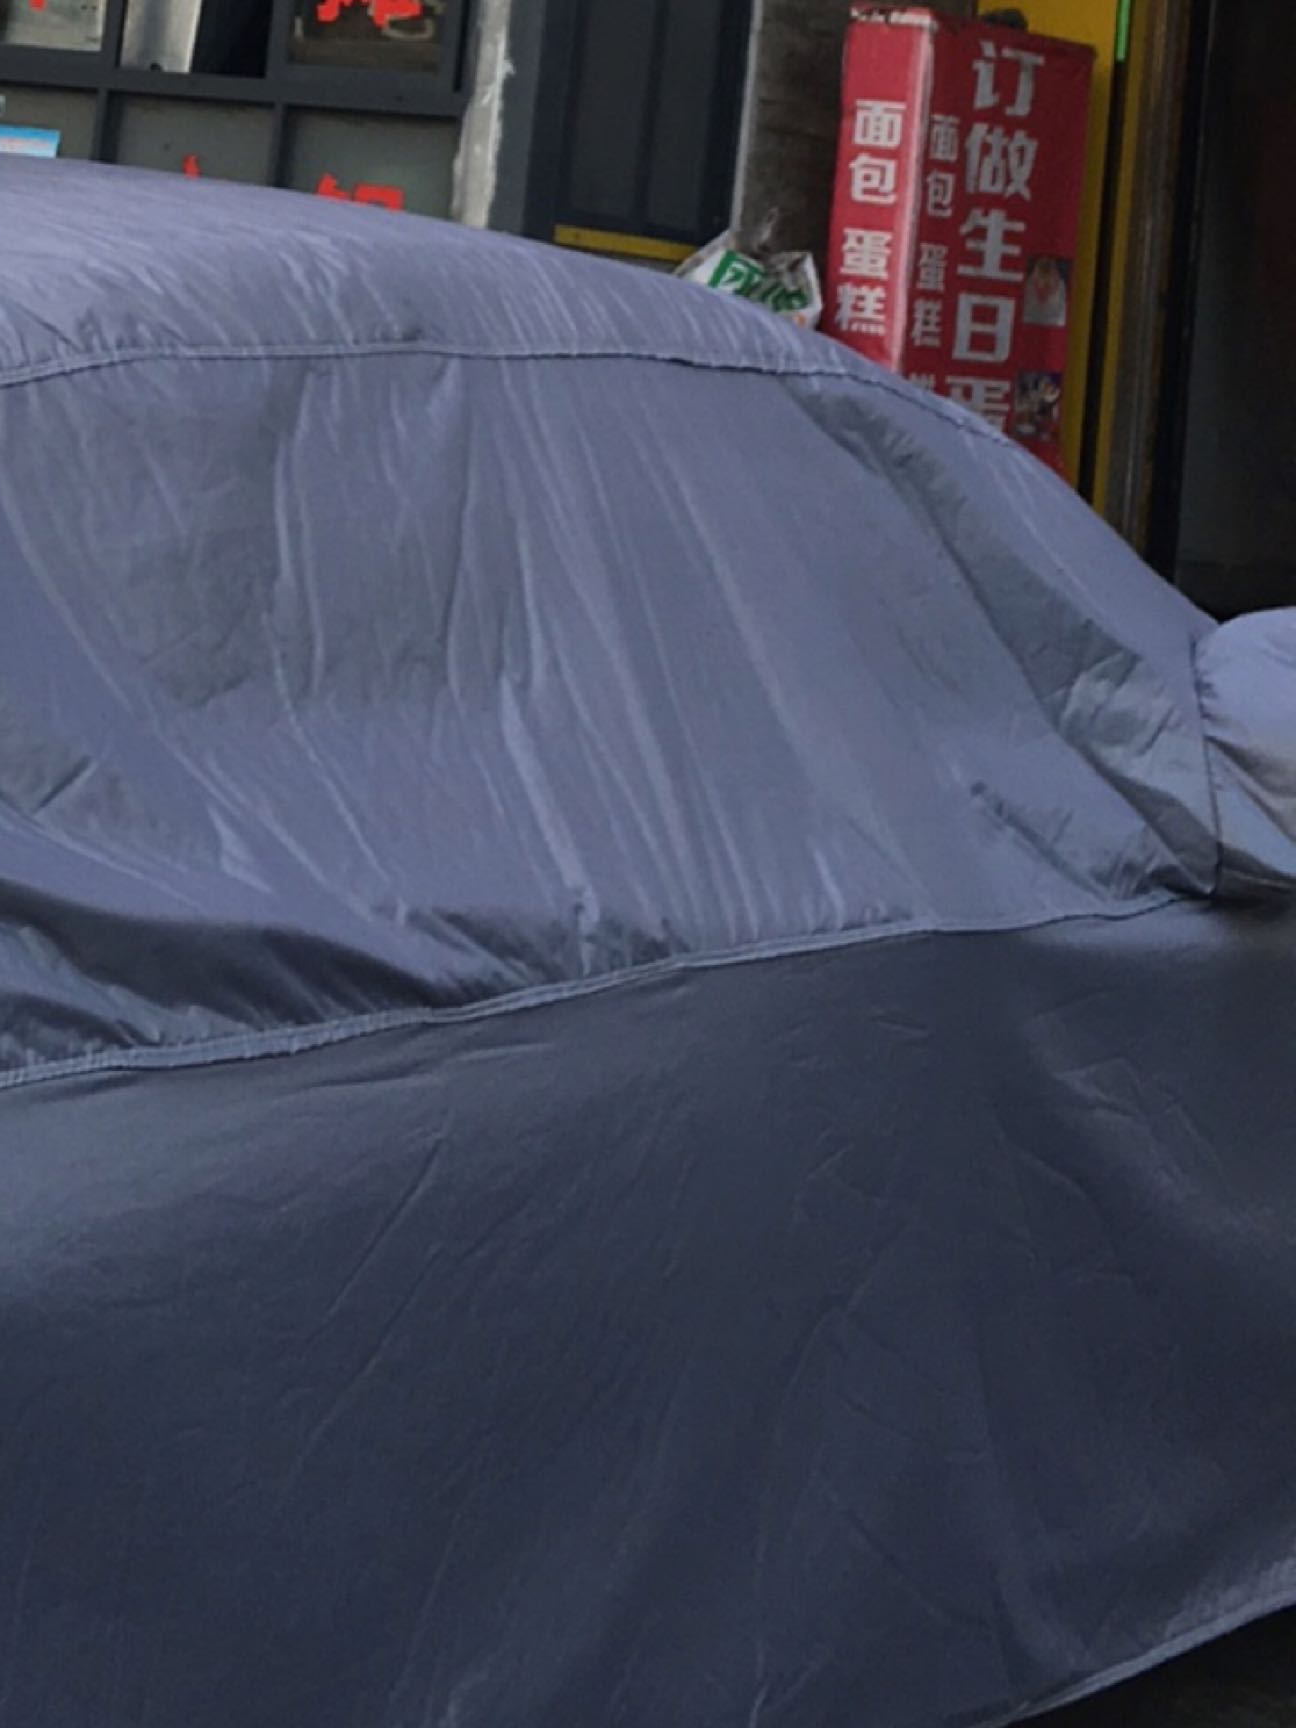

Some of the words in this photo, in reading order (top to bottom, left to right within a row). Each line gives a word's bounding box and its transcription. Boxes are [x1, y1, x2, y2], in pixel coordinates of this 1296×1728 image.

[849, 99, 906, 204] 面包
[926, 114, 959, 217] 面包
[834, 228, 892, 336] 蛋糕
[911, 243, 948, 346] 蛋糕
